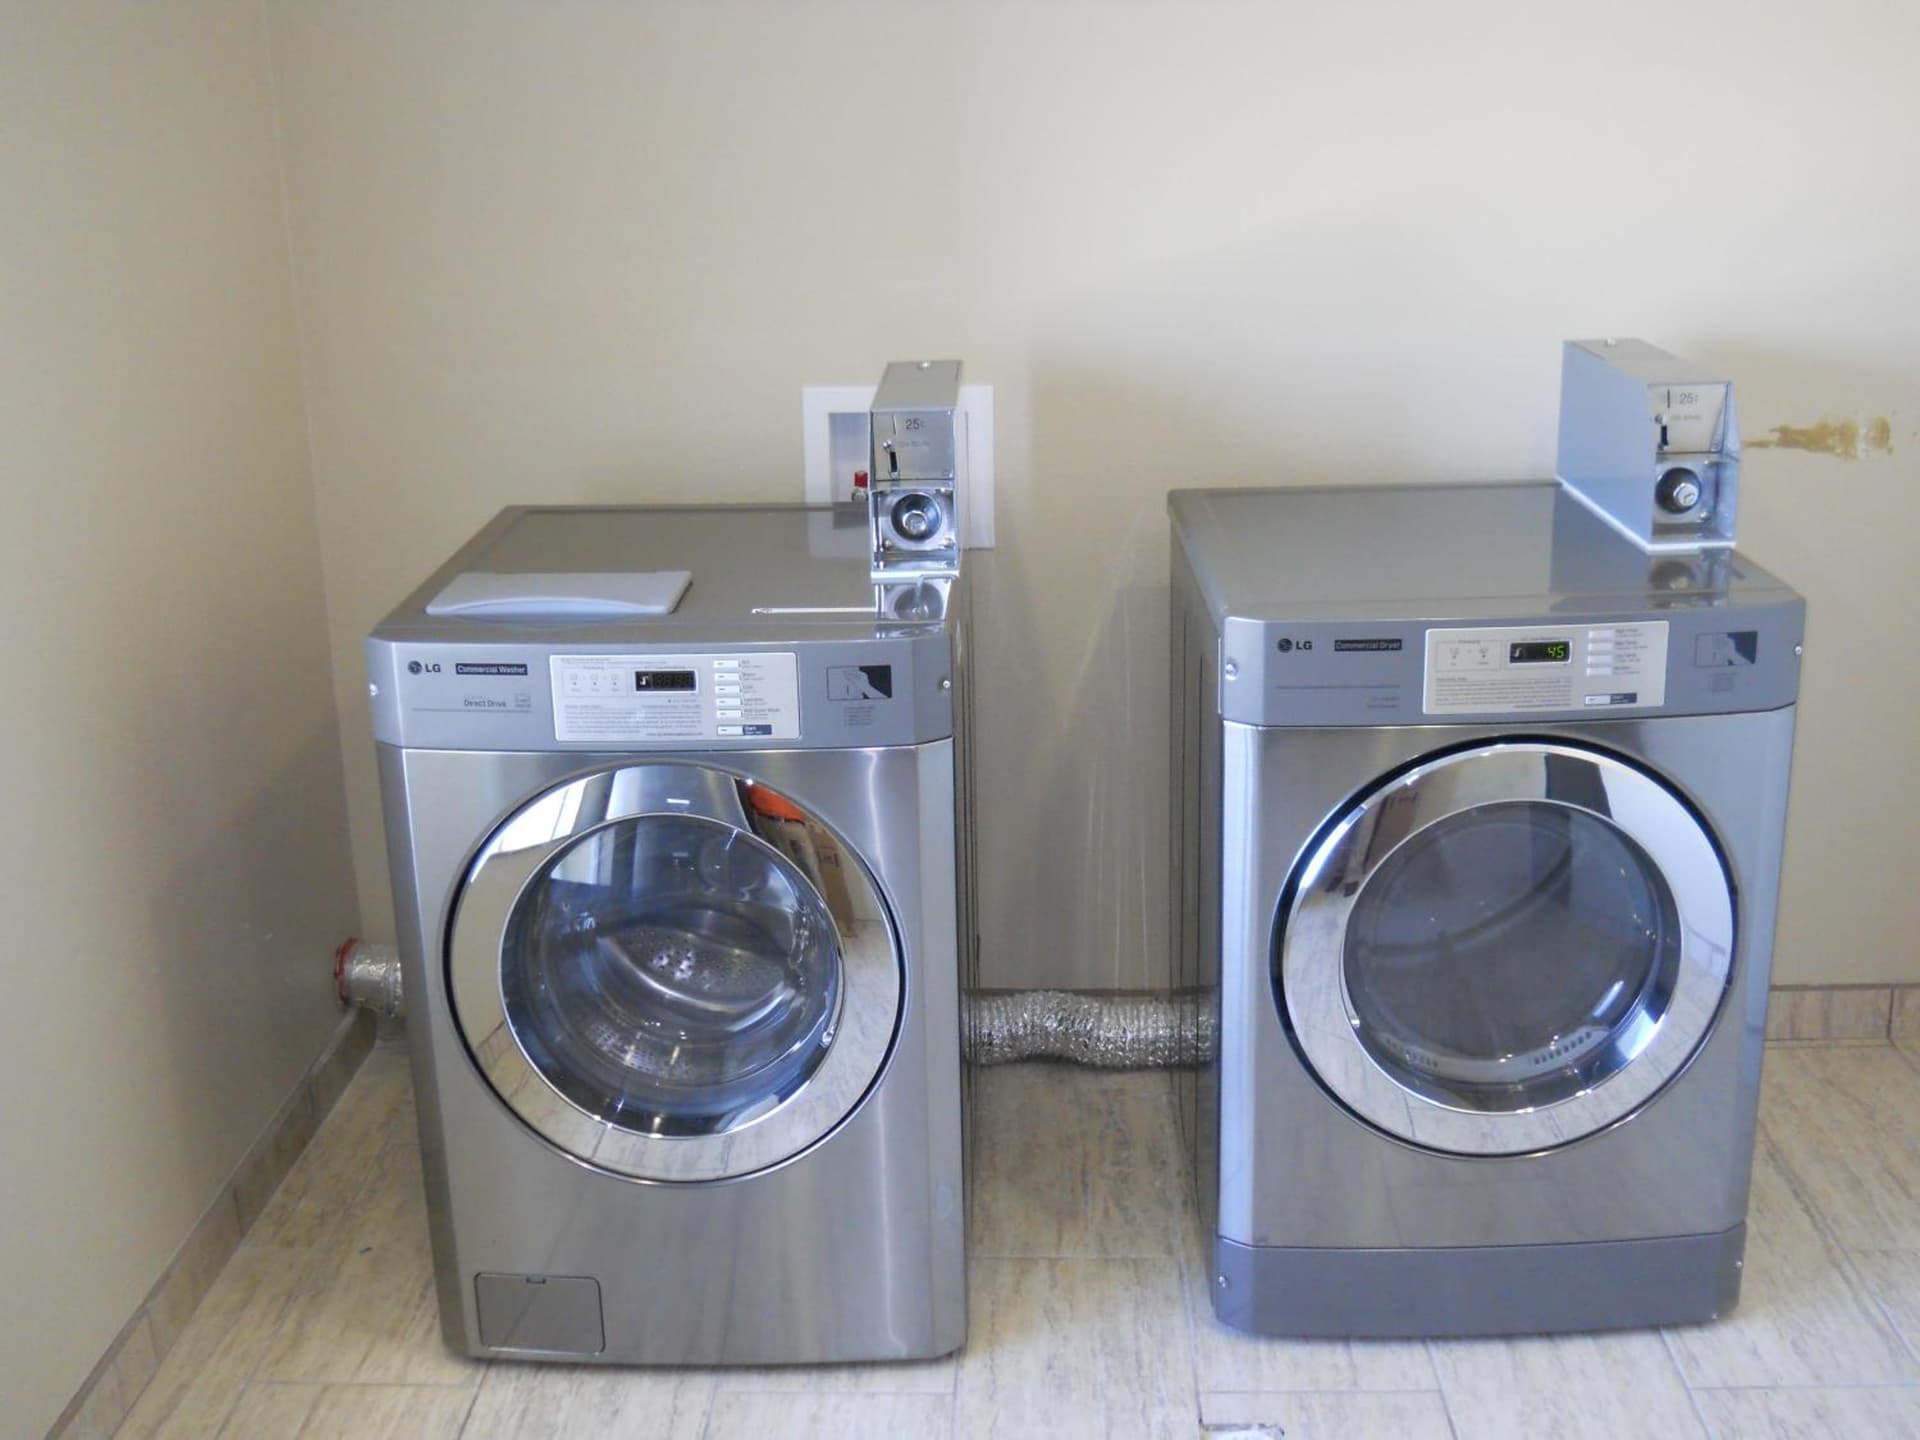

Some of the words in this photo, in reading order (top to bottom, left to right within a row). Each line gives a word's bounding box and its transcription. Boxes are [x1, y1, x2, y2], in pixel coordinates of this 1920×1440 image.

[1335, 640, 1378, 650] Commercial
[1379, 640, 1401, 651] Dryer
[1547, 645, 1565, 658] 45
[457, 664, 498, 674] Commercial
[499, 665, 526, 674] Washer
[464, 698, 486, 708] Direct
[487, 699, 507, 708] Drive
